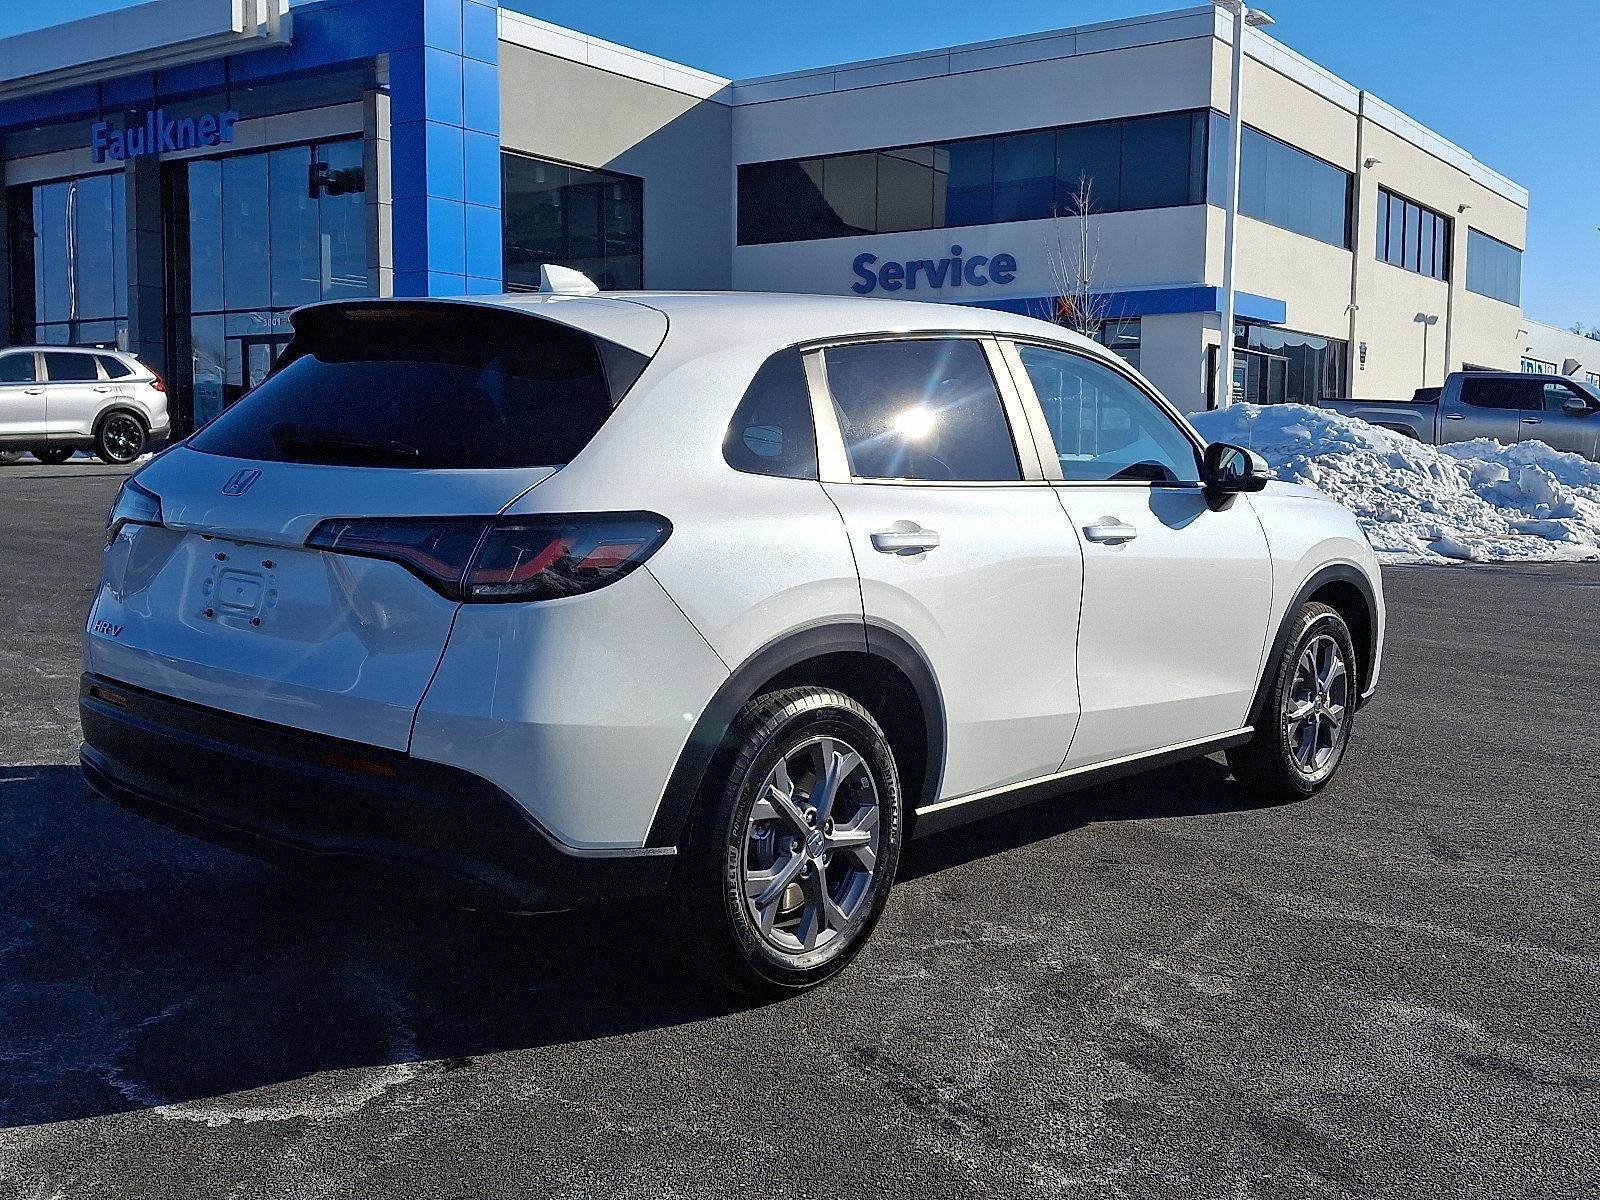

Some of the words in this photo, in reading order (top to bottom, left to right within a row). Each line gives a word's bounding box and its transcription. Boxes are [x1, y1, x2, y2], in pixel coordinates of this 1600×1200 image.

[91, 109, 239, 163] Faulkner
[851, 244, 1017, 294] Service
[94, 620, 123, 636] HR-V
[884, 768, 898, 840] MICHELIN
